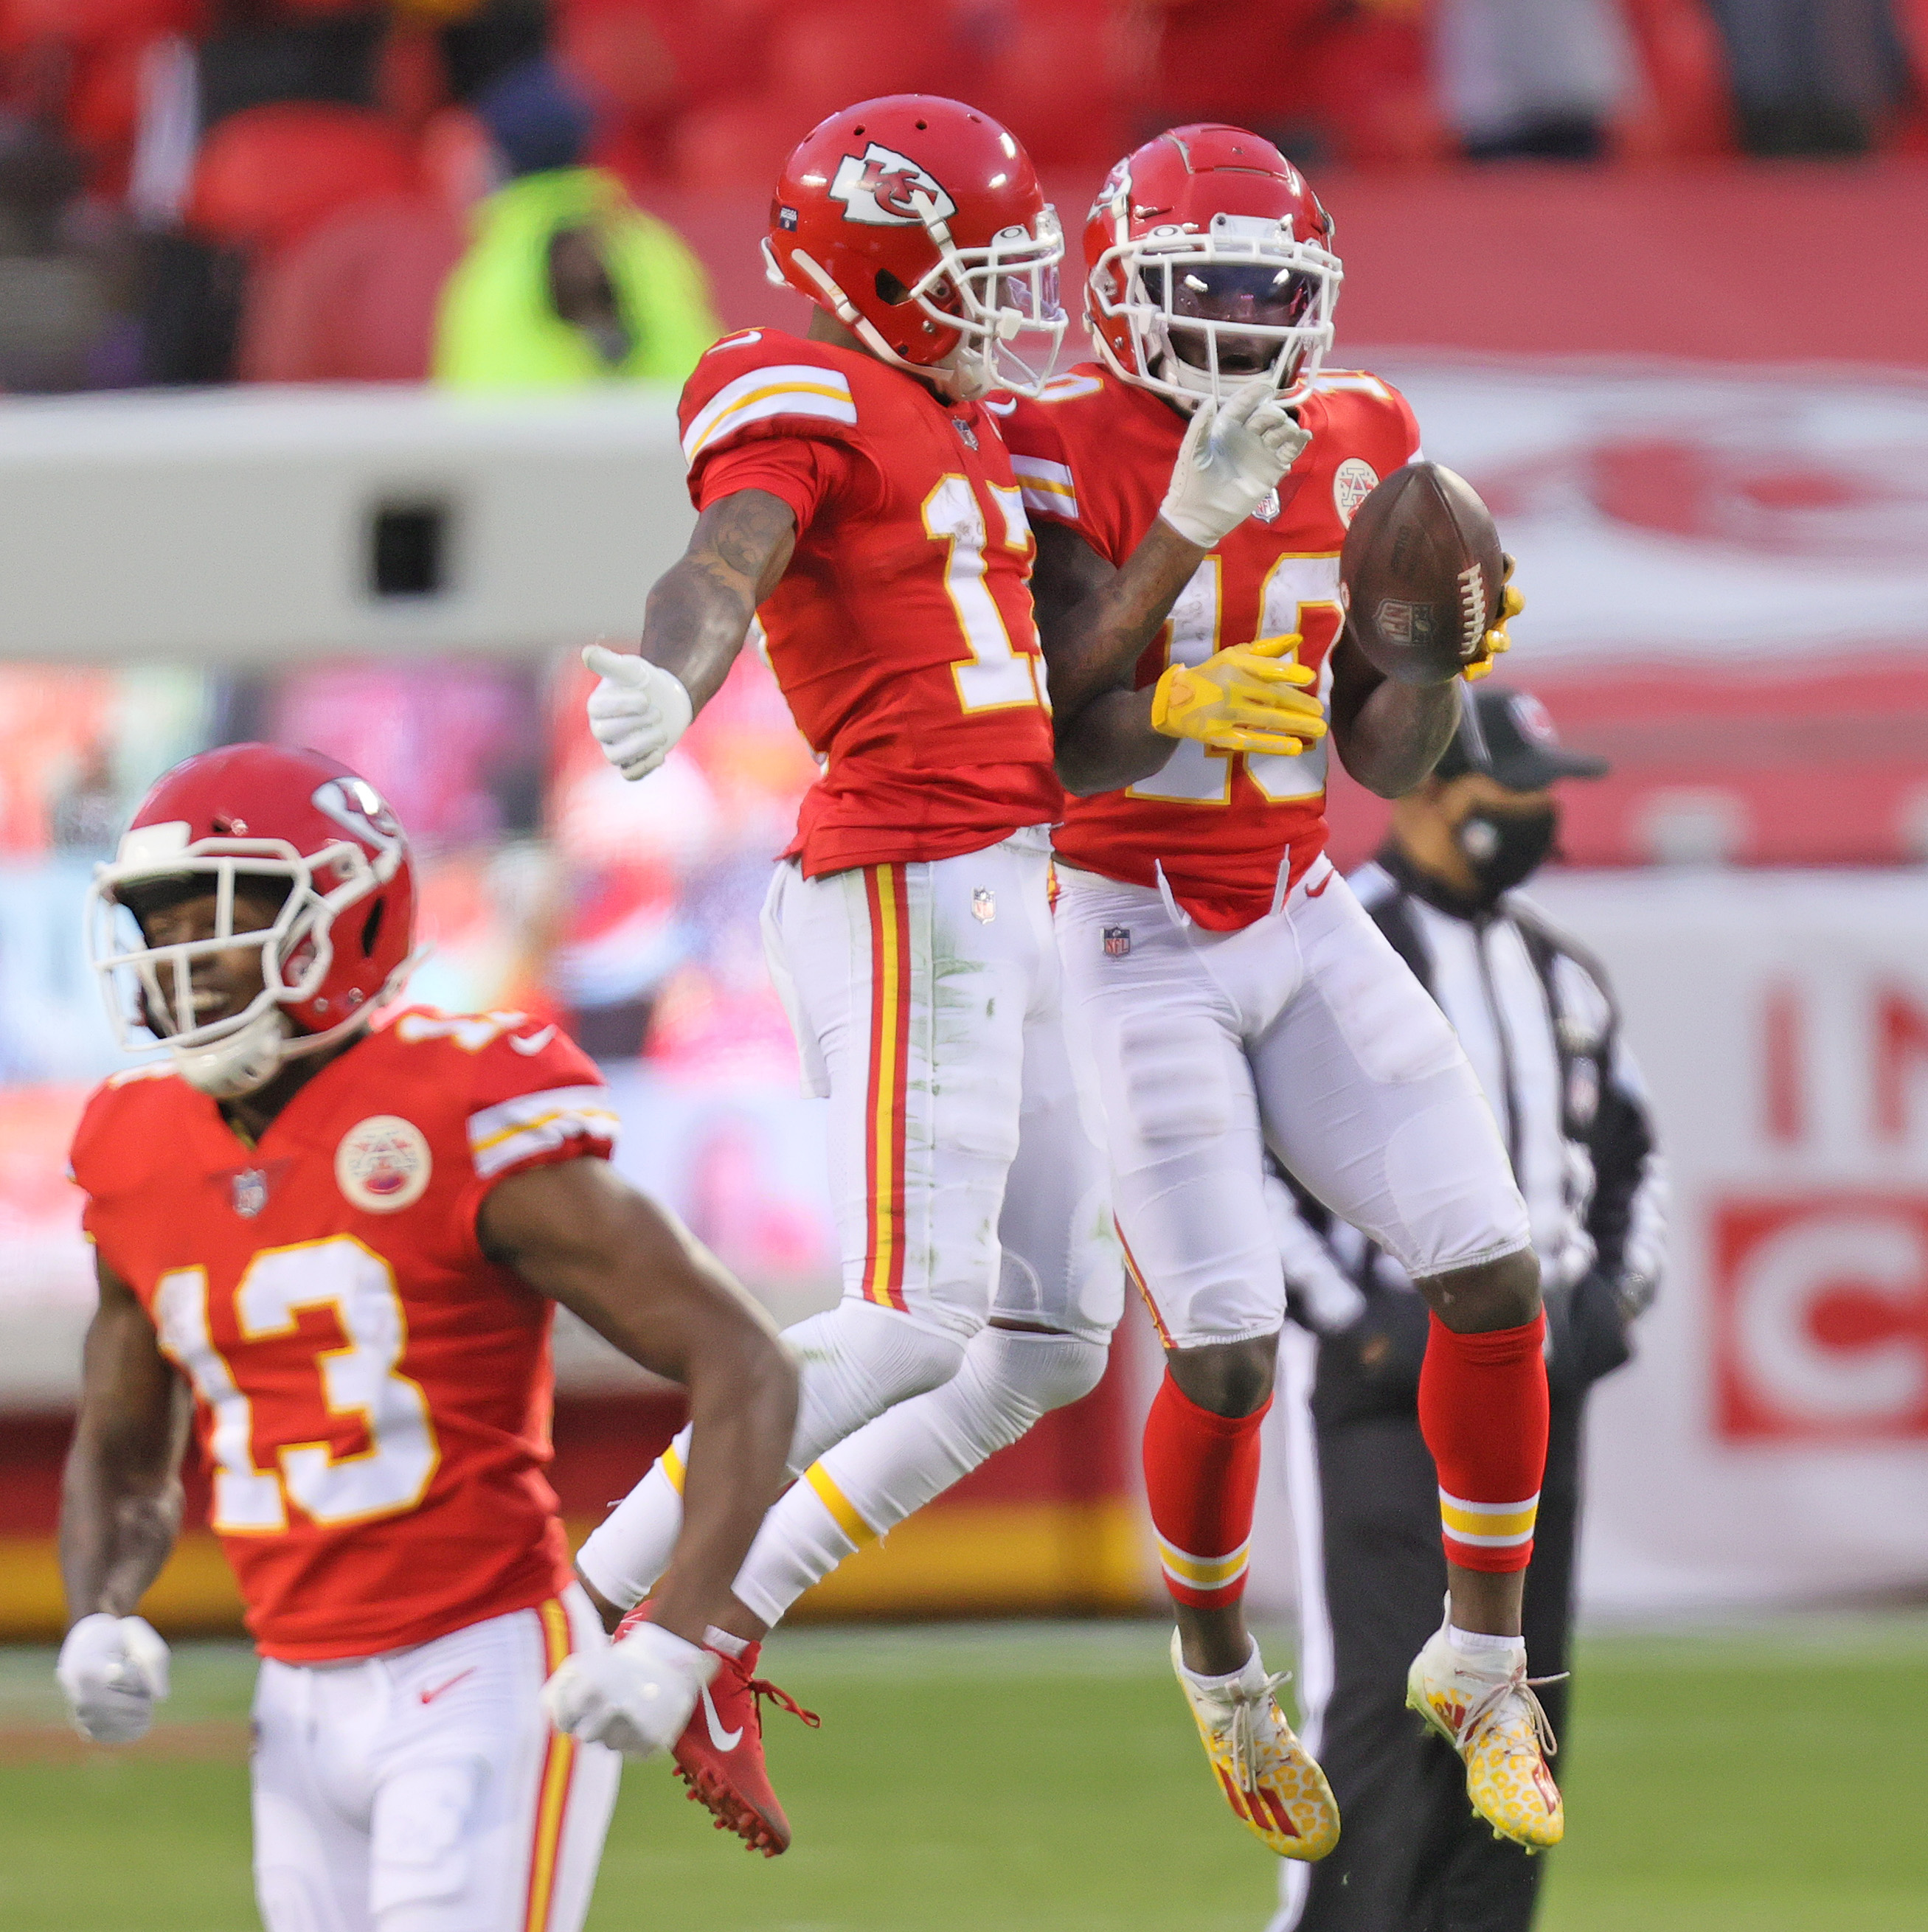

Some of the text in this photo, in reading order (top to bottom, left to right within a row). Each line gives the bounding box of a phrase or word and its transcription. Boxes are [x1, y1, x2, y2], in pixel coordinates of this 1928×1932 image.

[1125, 551, 1345, 805] 10
[1106, 938, 1129, 953] NFL
[150, 1232, 443, 1537] 13
